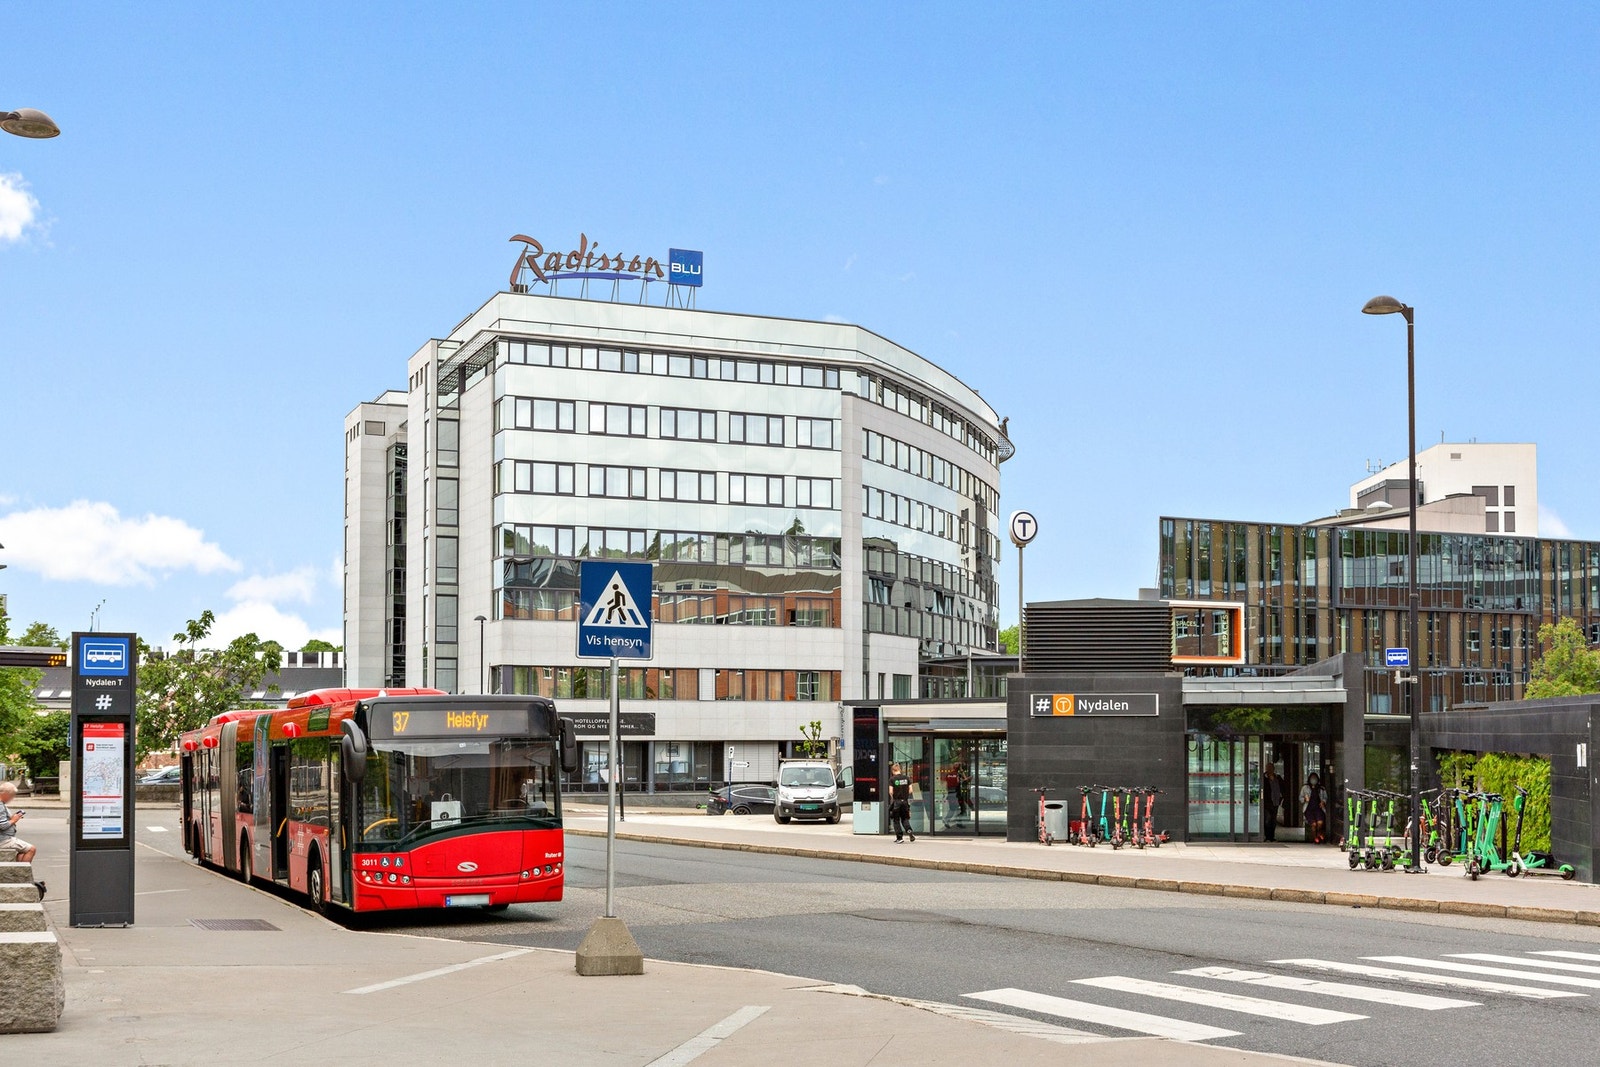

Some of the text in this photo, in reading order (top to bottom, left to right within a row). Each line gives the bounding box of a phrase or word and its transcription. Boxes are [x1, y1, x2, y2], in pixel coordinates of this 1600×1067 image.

[509, 233, 701, 287] Radisson BLU
[1017, 519, 1031, 537] T
[586, 635, 643, 648] Vis hensyn
[85, 679, 116, 687] Nydalen
[1078, 699, 1129, 713] Nydalen
[393, 711, 489, 732] 37 Helsfyr
